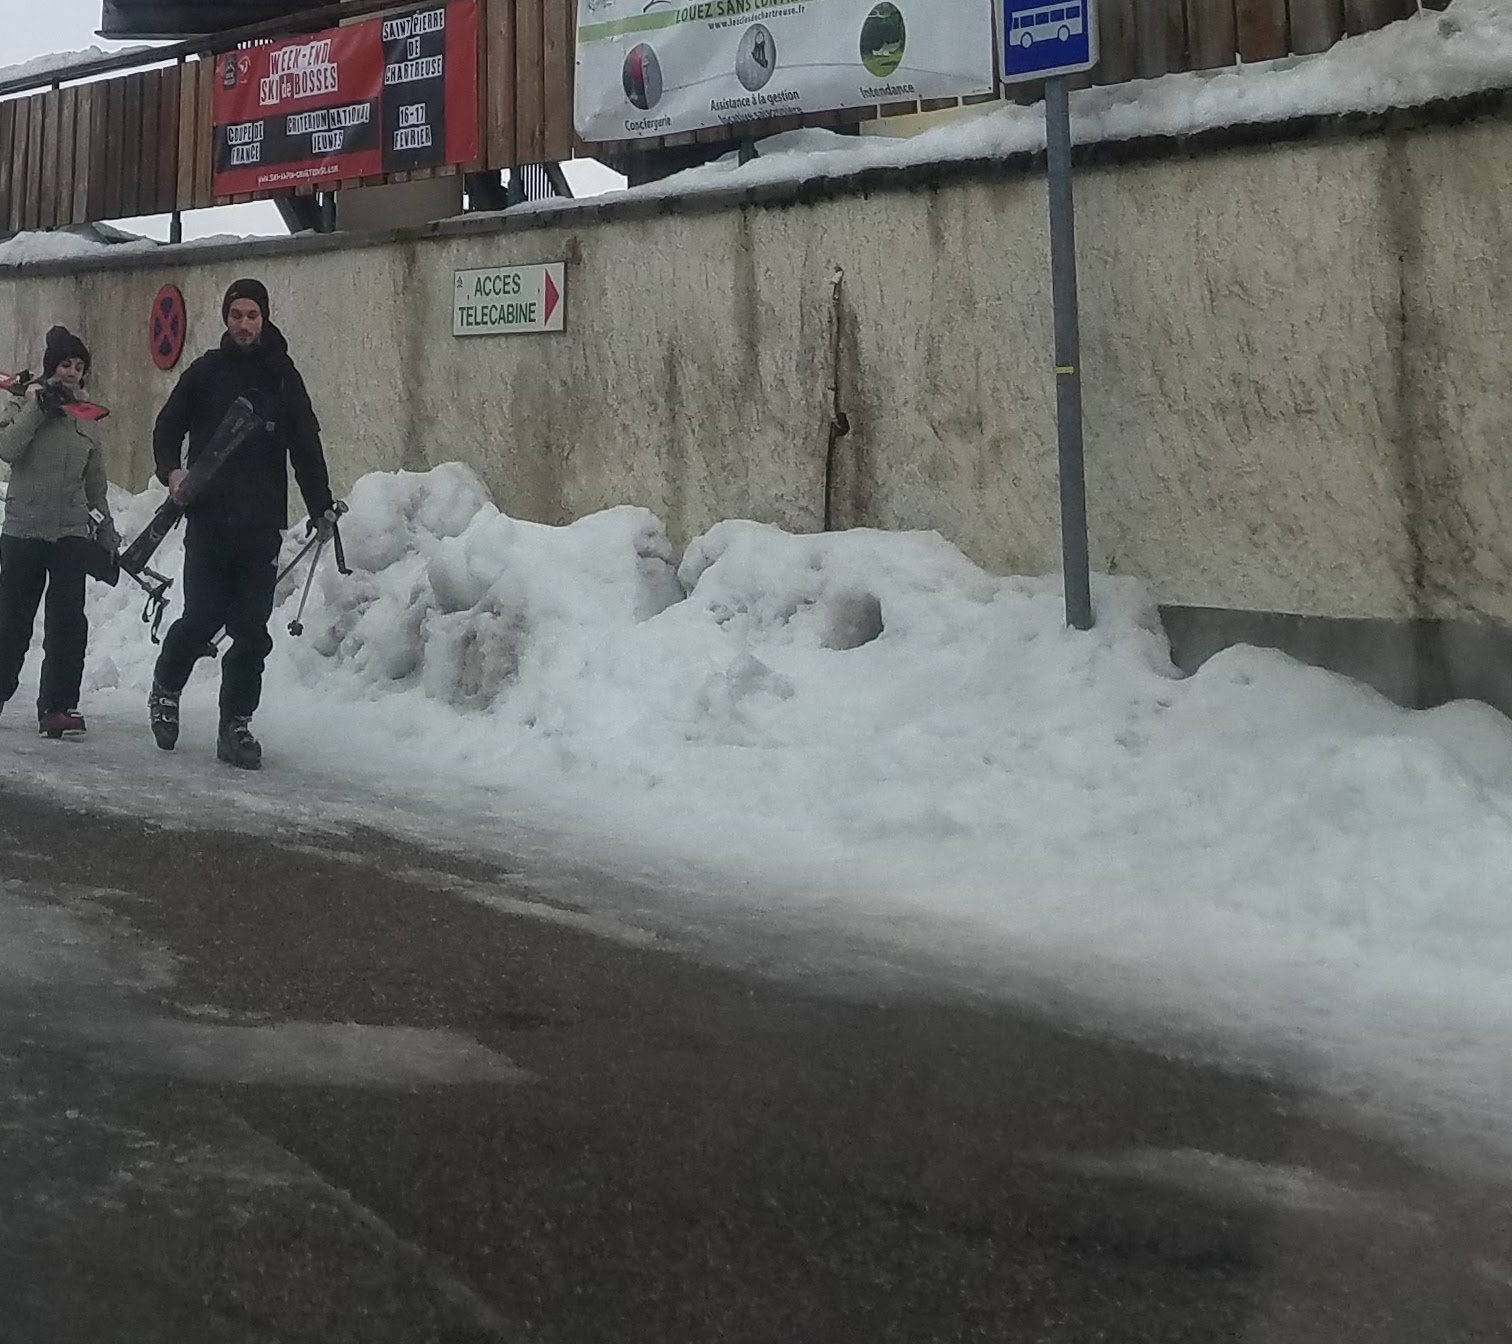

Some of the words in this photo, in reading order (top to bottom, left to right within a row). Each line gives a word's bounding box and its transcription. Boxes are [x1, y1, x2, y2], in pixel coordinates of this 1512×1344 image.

[676, 2, 713, 23] LOUEZ
[384, 19, 411, 39] SAINT
[413, 11, 443, 33] PIERRE
[271, 42, 330, 75] WEEK-END
[408, 39, 419, 57] DE
[385, 57, 442, 83] CHARTREUSE
[261, 79, 279, 102] SKI
[281, 75, 292, 99] de
[295, 66, 337, 95] BOSSES
[859, 82, 916, 99] Intendance
[767, 89, 800, 106] gestion
[287, 111, 327, 133] CRITERIUM
[400, 106, 425, 125] 16-17
[228, 125, 252, 143] COUPE
[395, 126, 432, 148] FEVRIER
[474, 272, 521, 297] ACCES
[458, 301, 537, 327] TELECABINE
